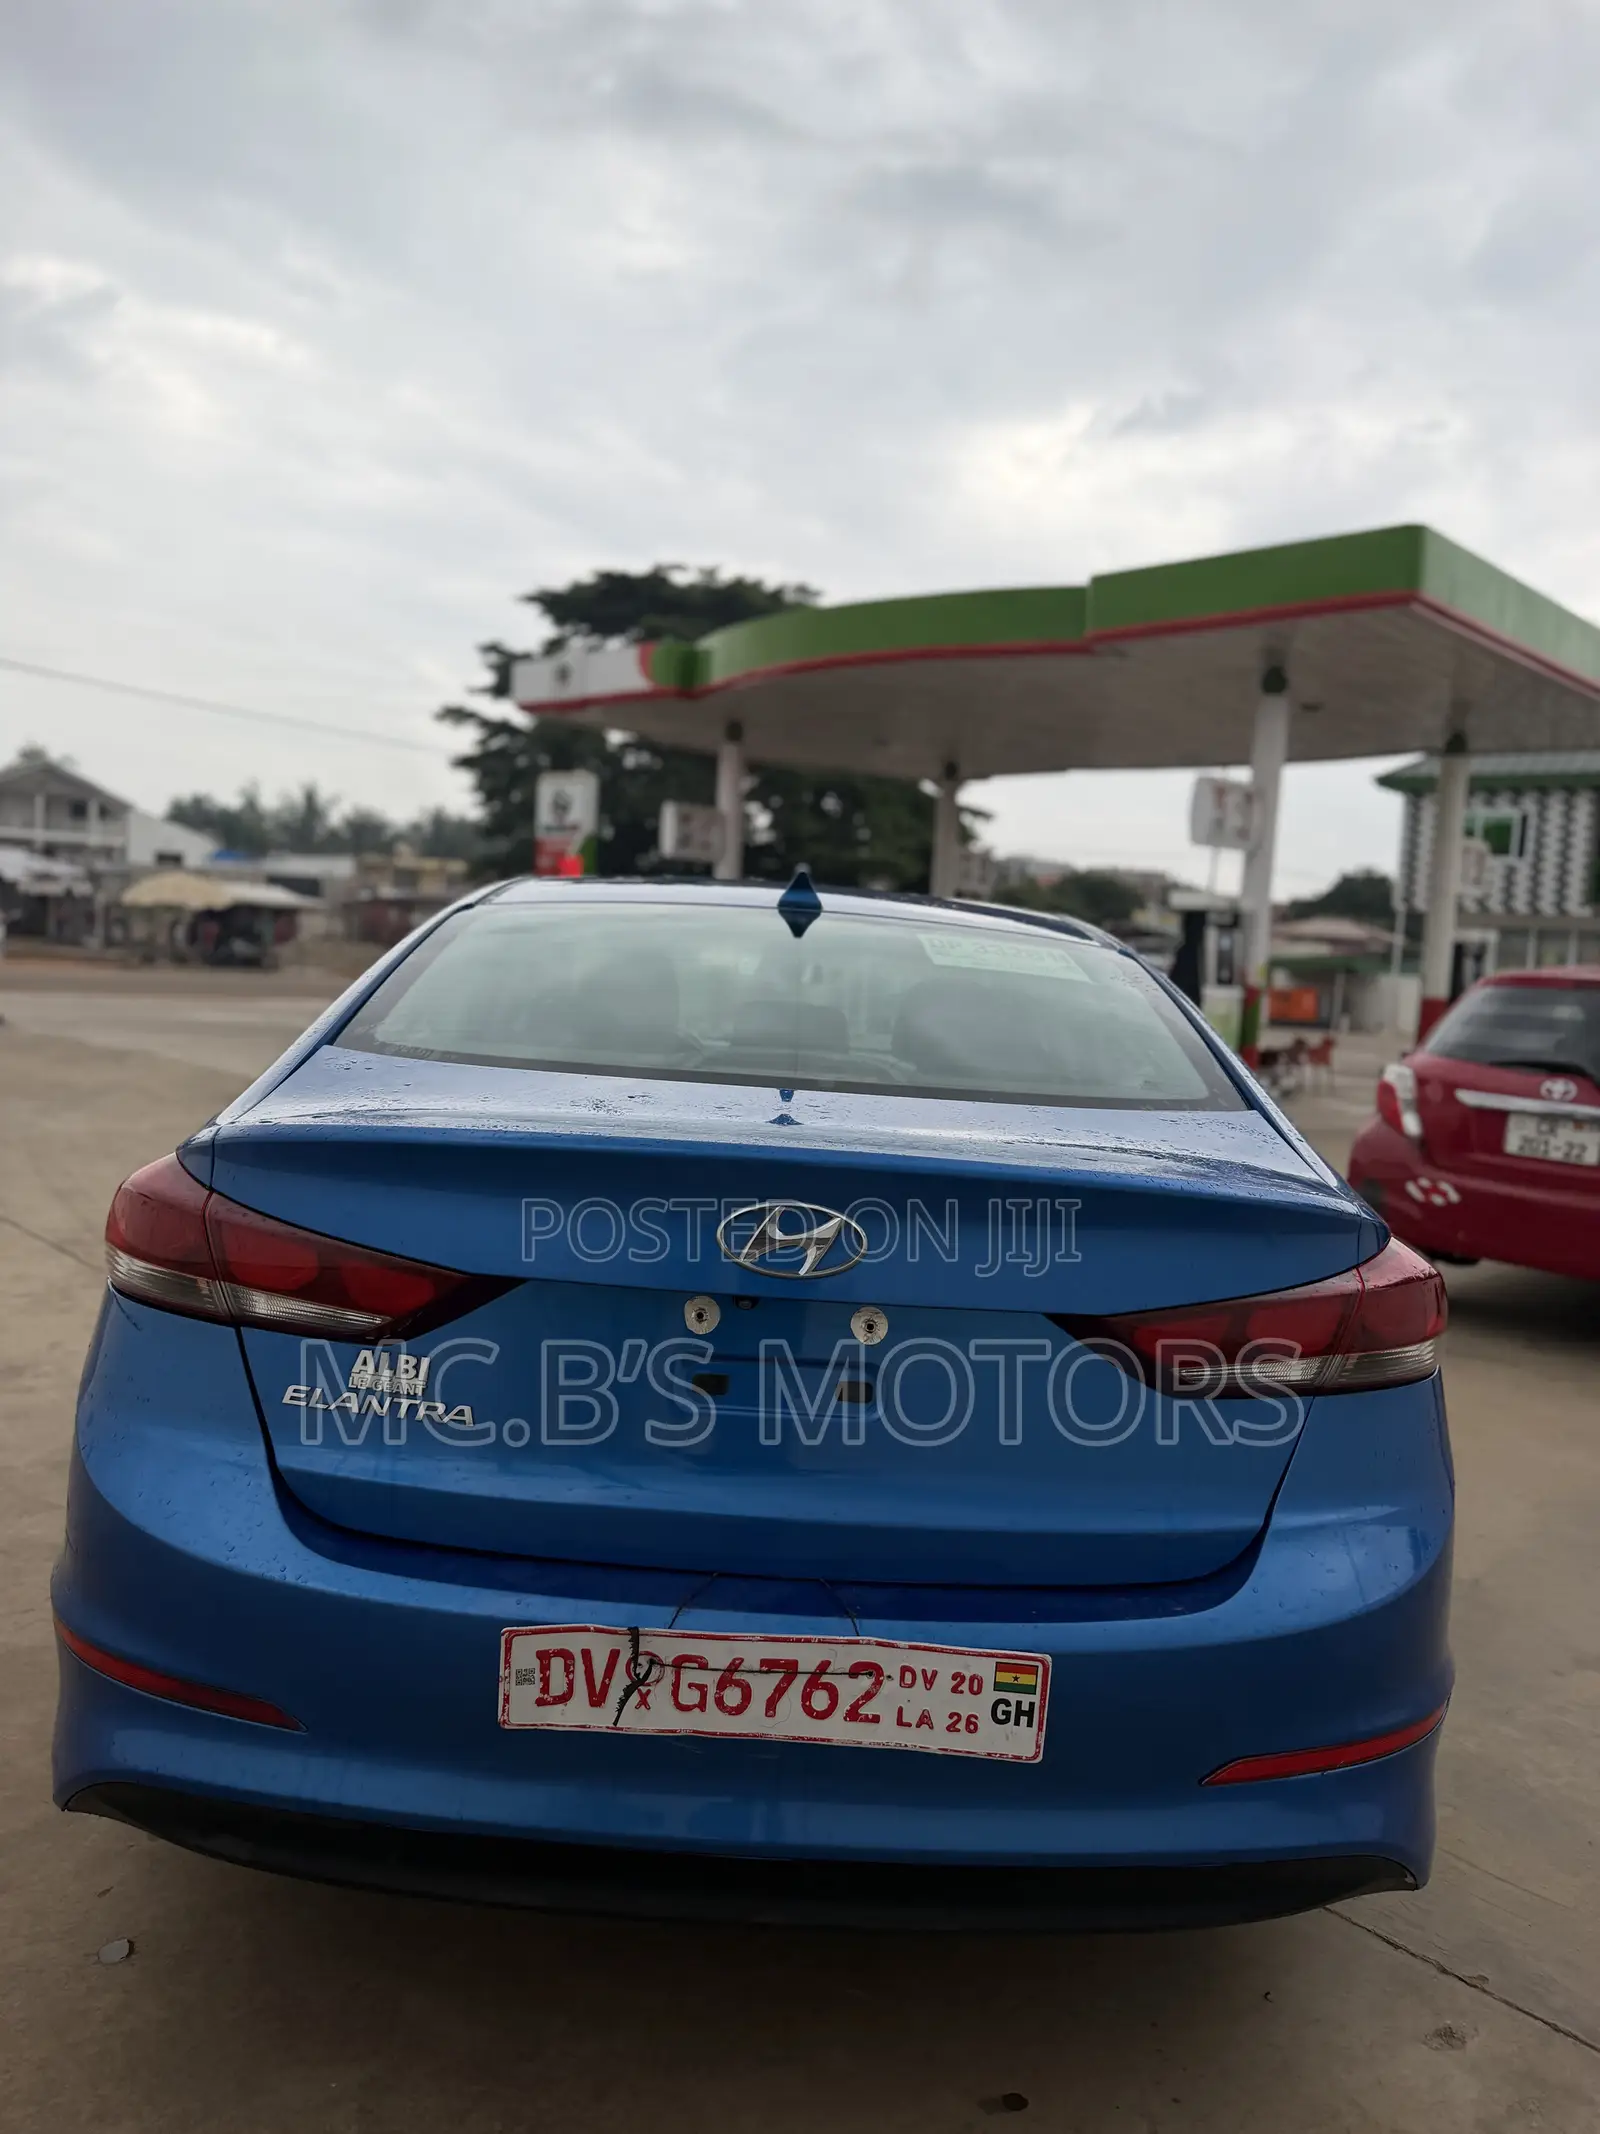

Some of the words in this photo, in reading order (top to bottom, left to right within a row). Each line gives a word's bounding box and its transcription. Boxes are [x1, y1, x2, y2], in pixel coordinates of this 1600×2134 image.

[350, 1349, 431, 1381] ALBI
[348, 1375, 368, 1389] LE
[281, 1385, 474, 1427] ELANTRA
[534, 1648, 620, 1708] DV
[671, 1653, 883, 1723] G6762
[899, 1664, 938, 1691] DV
[950, 1671, 984, 1696] 20
[896, 1705, 934, 1730] LA
[945, 1711, 979, 1734] 26
[990, 1697, 1036, 1729] GH
